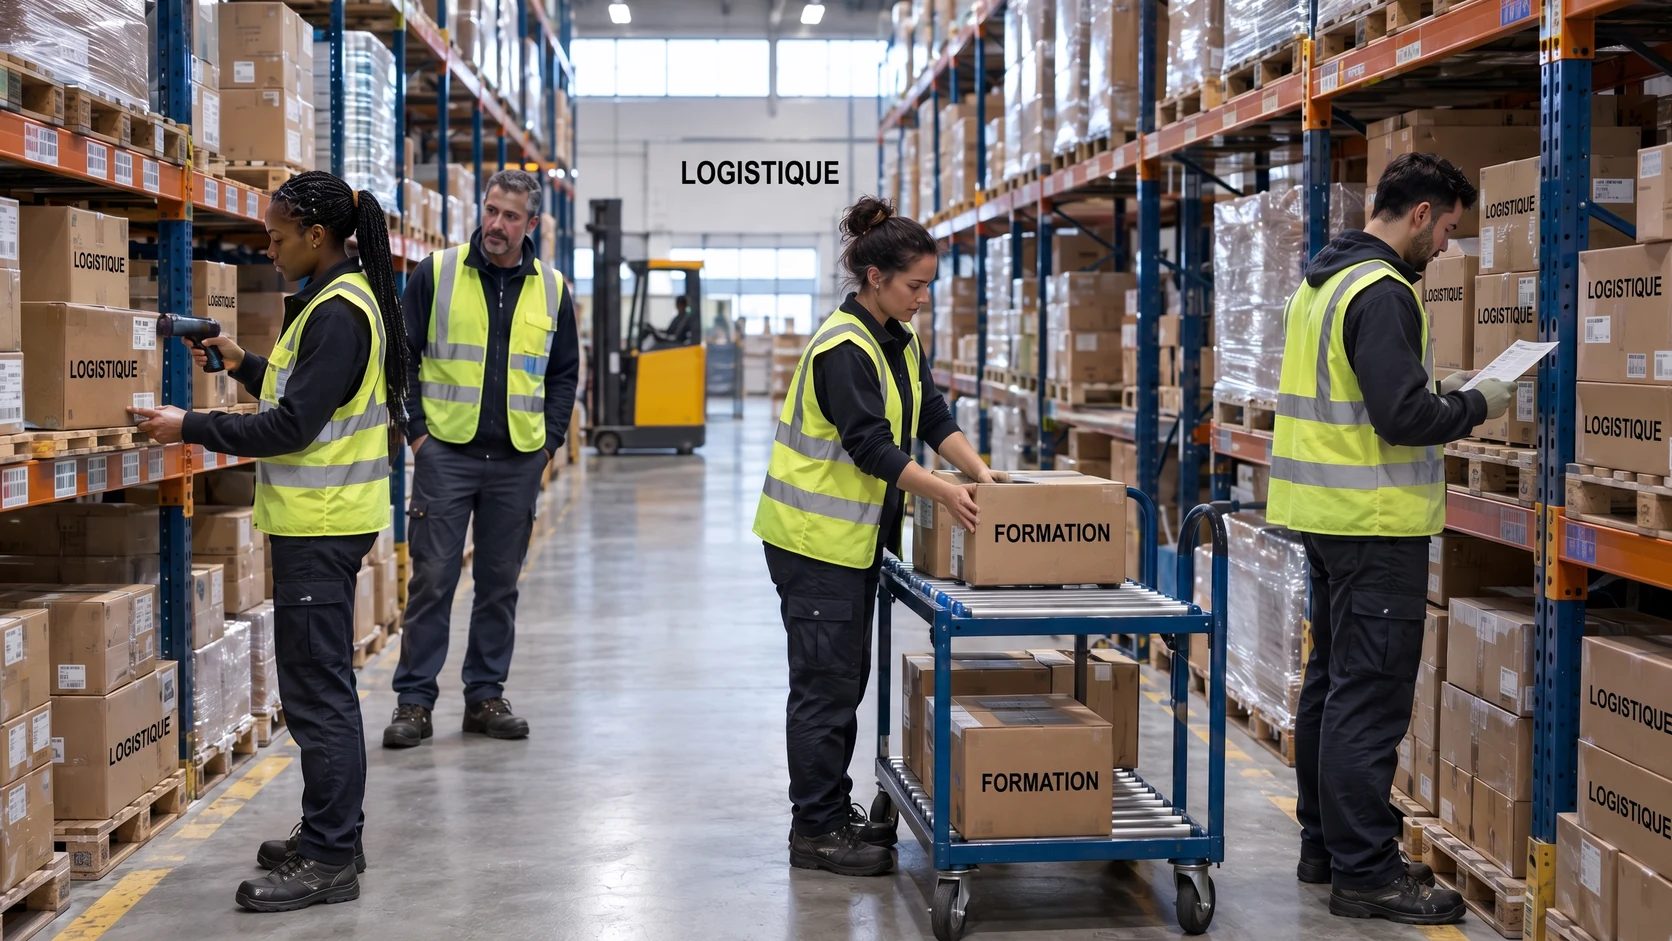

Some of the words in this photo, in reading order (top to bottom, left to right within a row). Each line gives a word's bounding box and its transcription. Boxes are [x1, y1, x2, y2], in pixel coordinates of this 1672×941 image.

[681, 160, 840, 187] LOGISTIQUE
[1485, 194, 1536, 219] LOGISTIQUE
[74, 251, 125, 274] LOGISTIQUE
[1424, 286, 1463, 303] LOGISTIQUE
[1587, 275, 1663, 299] LOGISTIQUE
[207, 294, 236, 309] LOGISTIQUE
[1477, 306, 1533, 325] LOGISTIQUE
[70, 359, 138, 380] LOGISTIQUE
[1584, 414, 1663, 442] LOGISTIQUE
[994, 523, 1111, 543] FORMATION
[1589, 684, 1672, 736] LOGISTIQUE
[108, 715, 172, 767] LOGISTIQUE
[981, 770, 1099, 793] FORMATION
[1588, 780, 1672, 841] LOGISTIQUE
